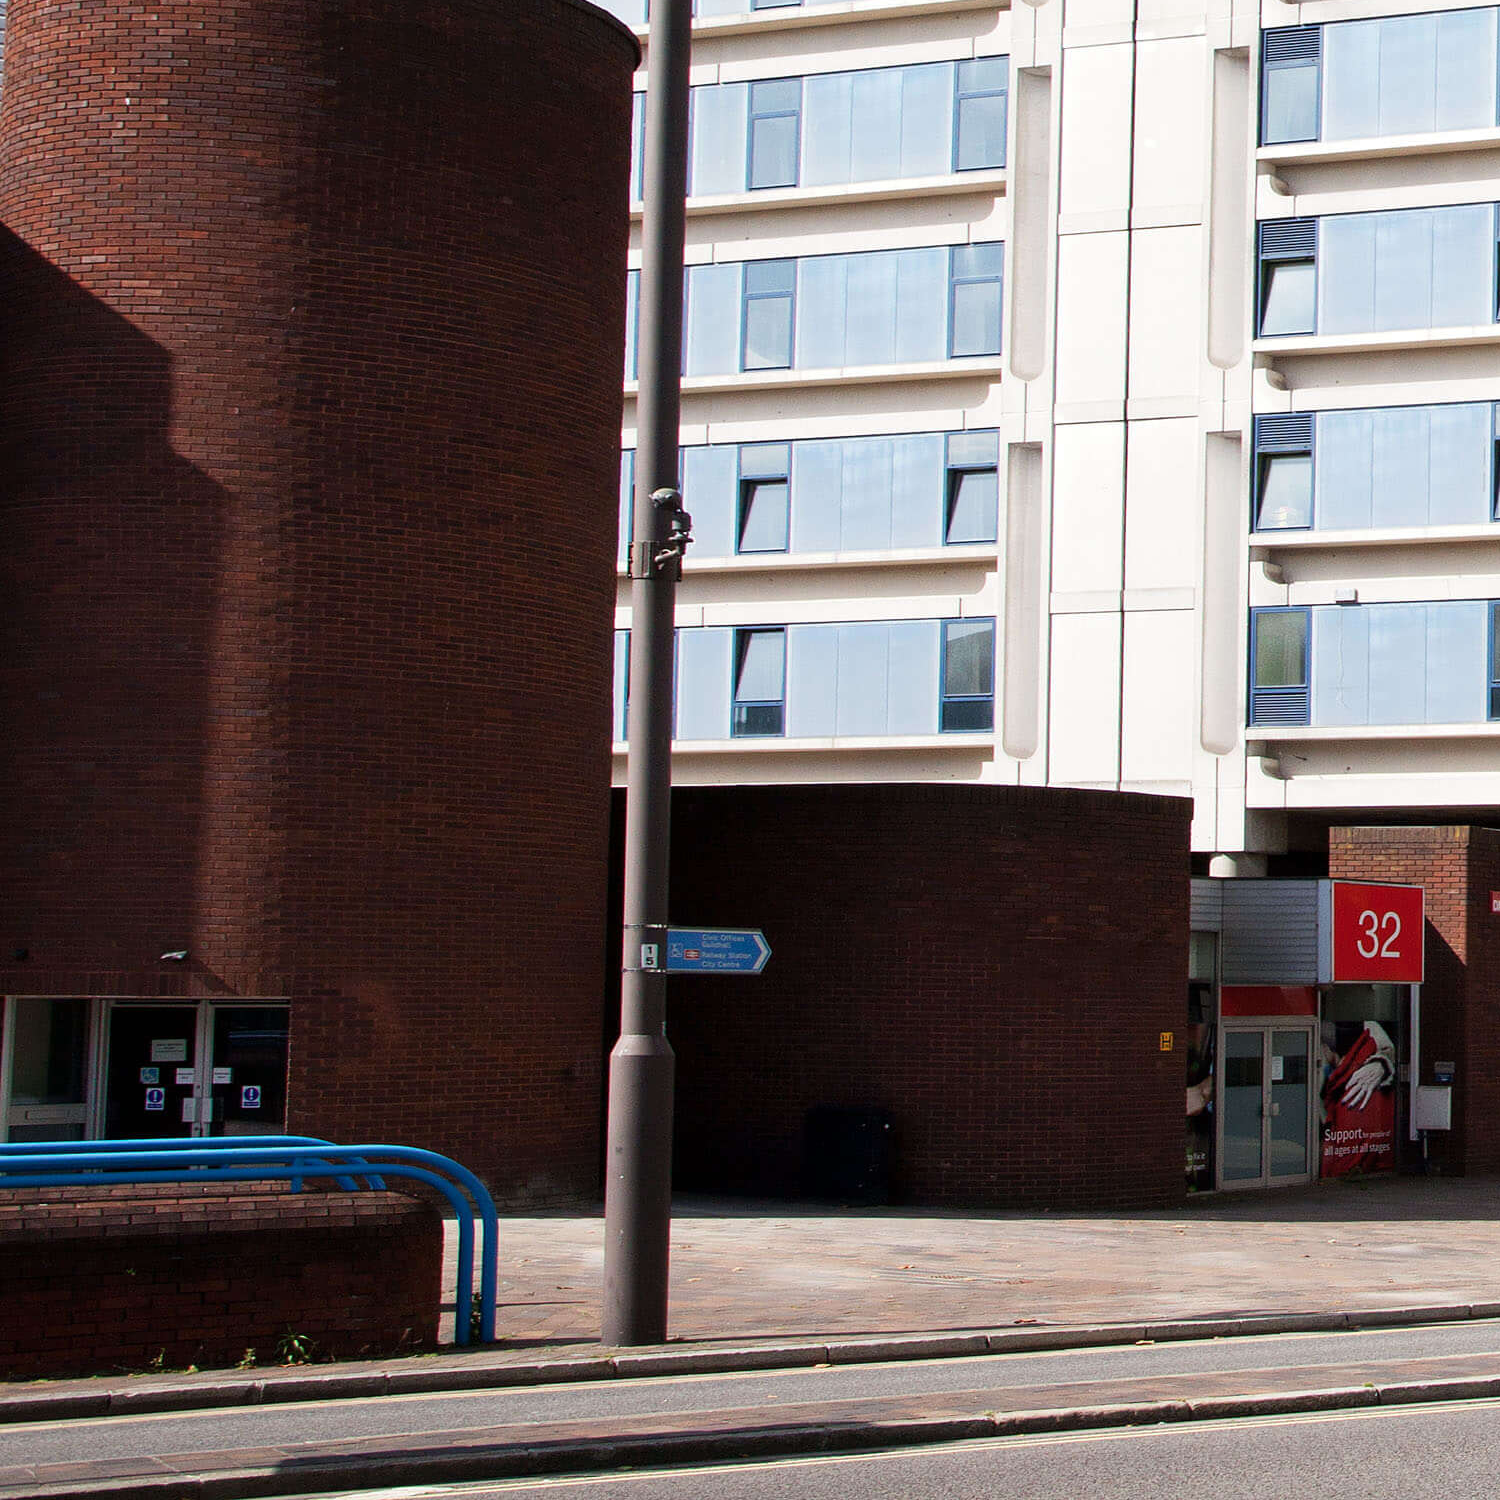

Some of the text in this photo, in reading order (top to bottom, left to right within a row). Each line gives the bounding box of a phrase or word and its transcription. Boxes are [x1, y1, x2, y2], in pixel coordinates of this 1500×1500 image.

[720, 934, 745, 942] Offices
[1357, 910, 1401, 958] 32
[1324, 1128, 1362, 1144] Support
[1324, 1143, 1390, 1157] all ages at all stages
